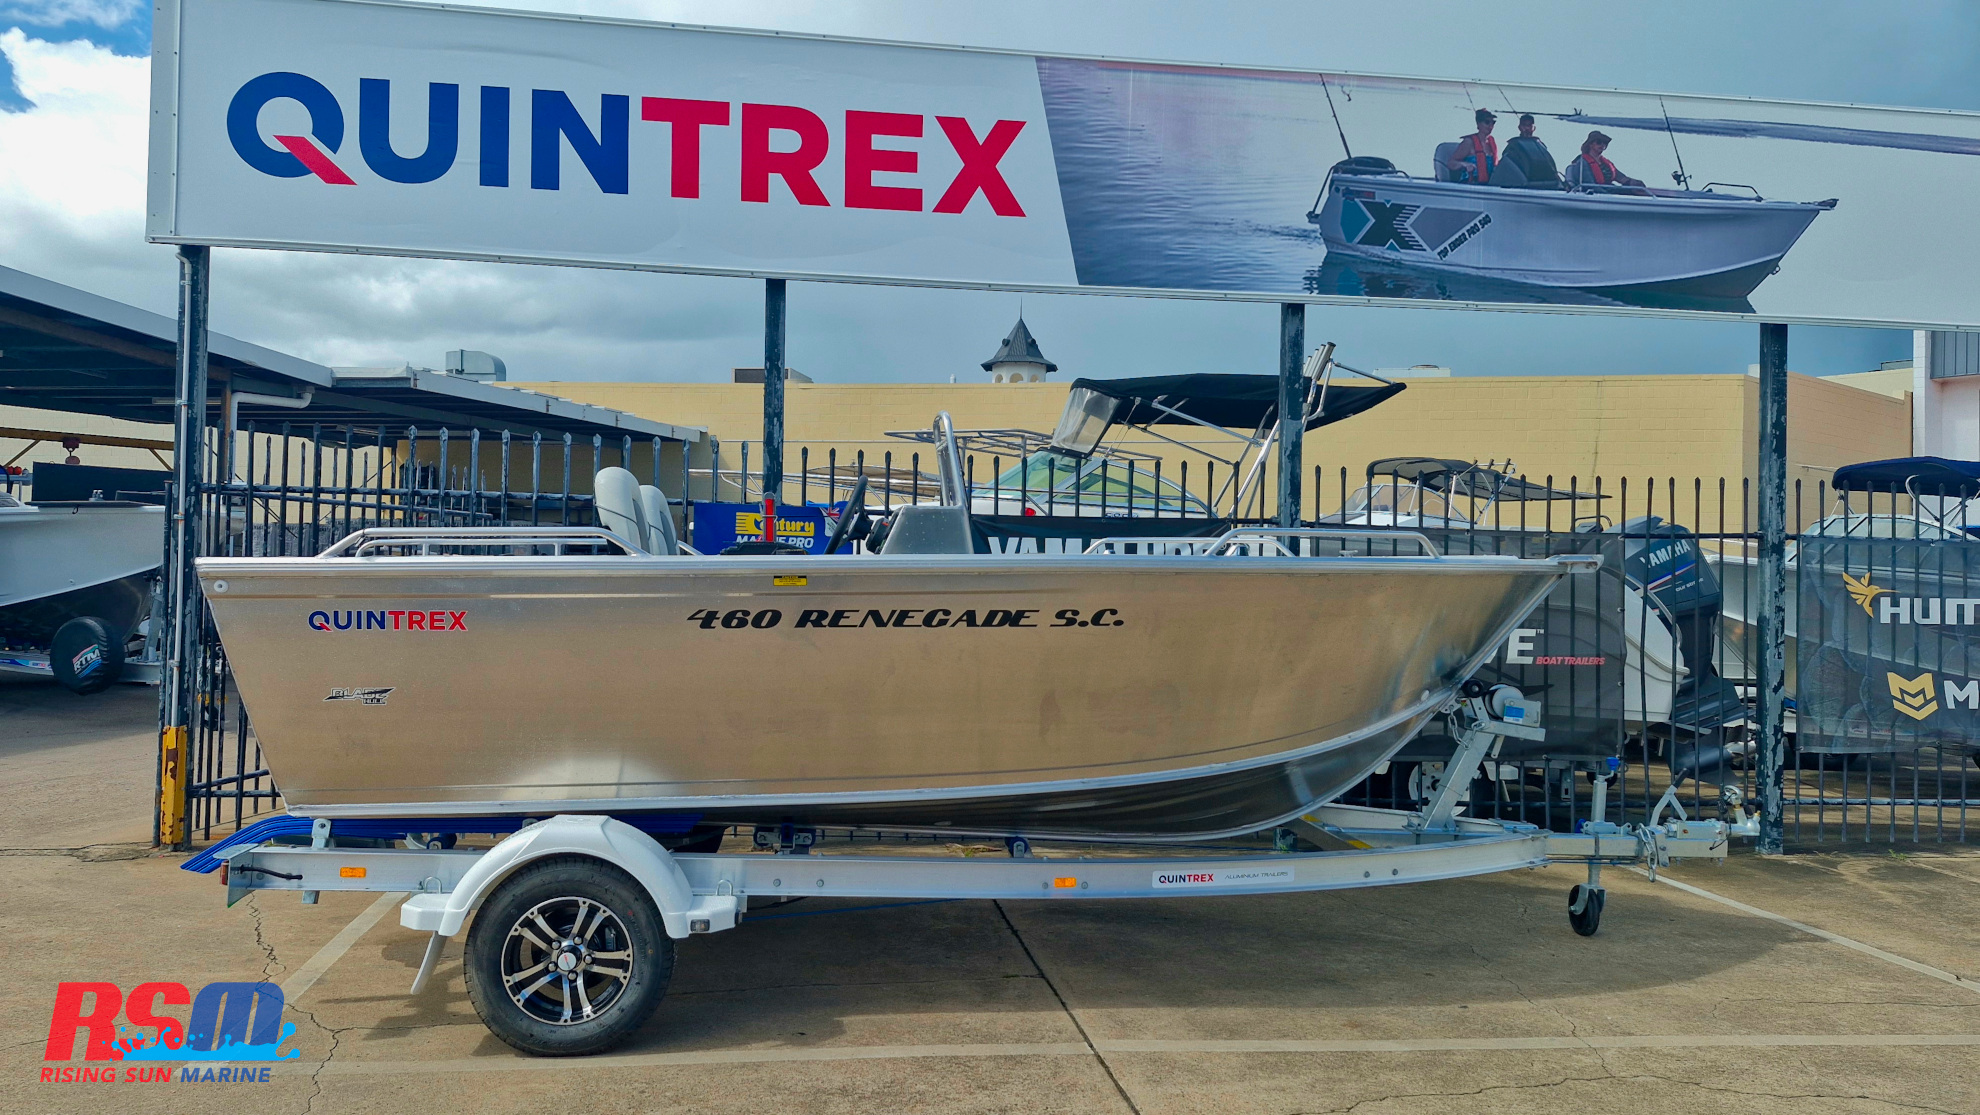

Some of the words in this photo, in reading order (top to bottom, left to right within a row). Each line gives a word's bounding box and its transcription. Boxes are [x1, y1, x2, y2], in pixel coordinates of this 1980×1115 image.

[226, 71, 1028, 218] QUINTREX
[735, 512, 815, 537] Ctury
[788, 537, 815, 548] PRO
[308, 610, 469, 632] QUINTREX
[687, 608, 782, 629] 460
[795, 609, 1040, 628] RENEGADE
[1049, 608, 1126, 627] S.C.
[1535, 656, 1565, 666] BOAT
[1564, 656, 1606, 666] TRAILERS
[1158, 873, 1214, 884] QUINTREX
